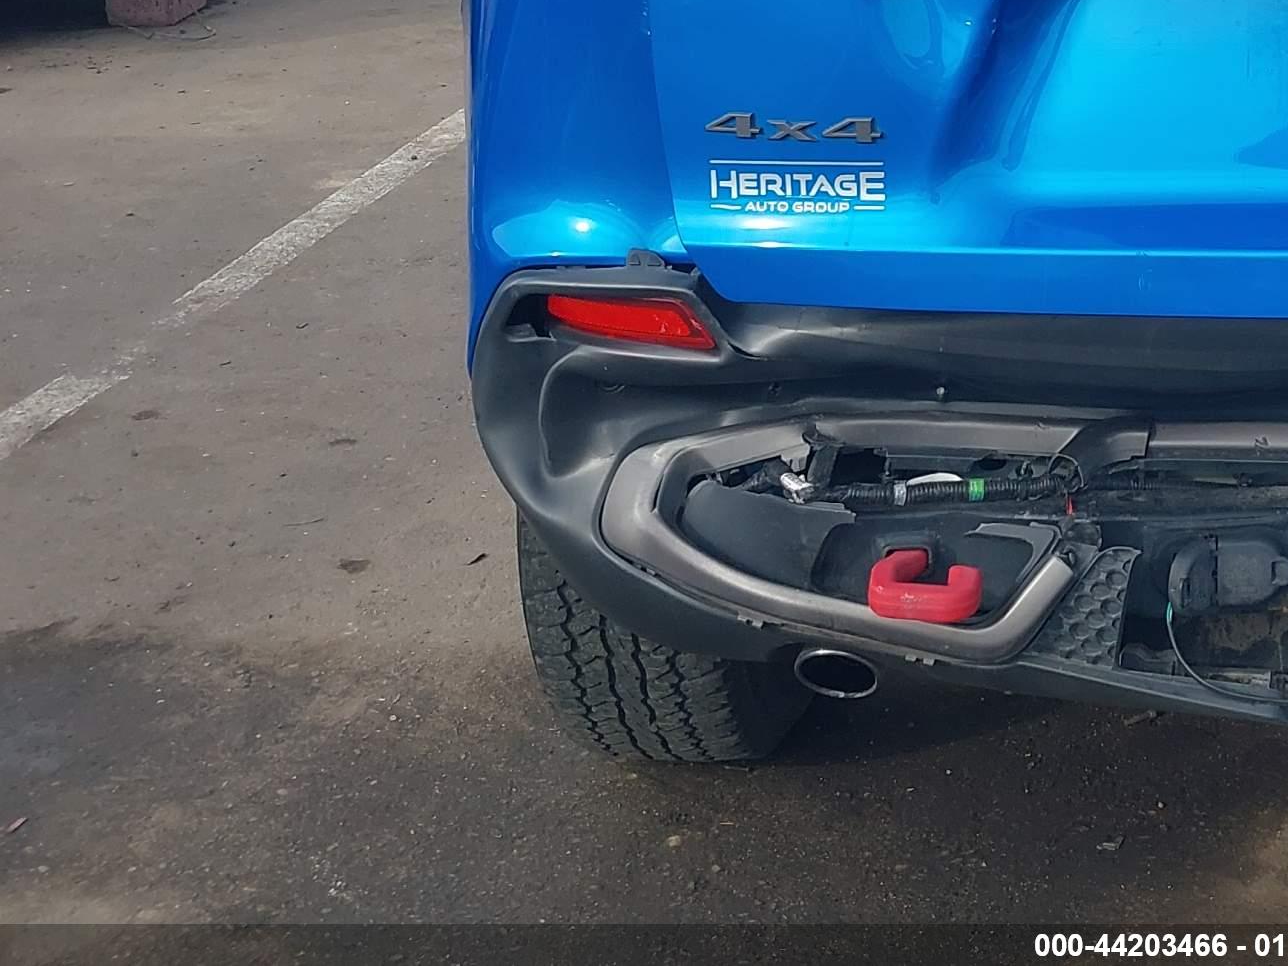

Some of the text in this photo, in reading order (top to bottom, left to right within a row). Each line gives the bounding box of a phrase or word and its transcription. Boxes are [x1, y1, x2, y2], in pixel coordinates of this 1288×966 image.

[704, 111, 884, 143] 4x4
[709, 169, 886, 202] HERITAGE
[744, 201, 850, 214] AUTO GROUP
